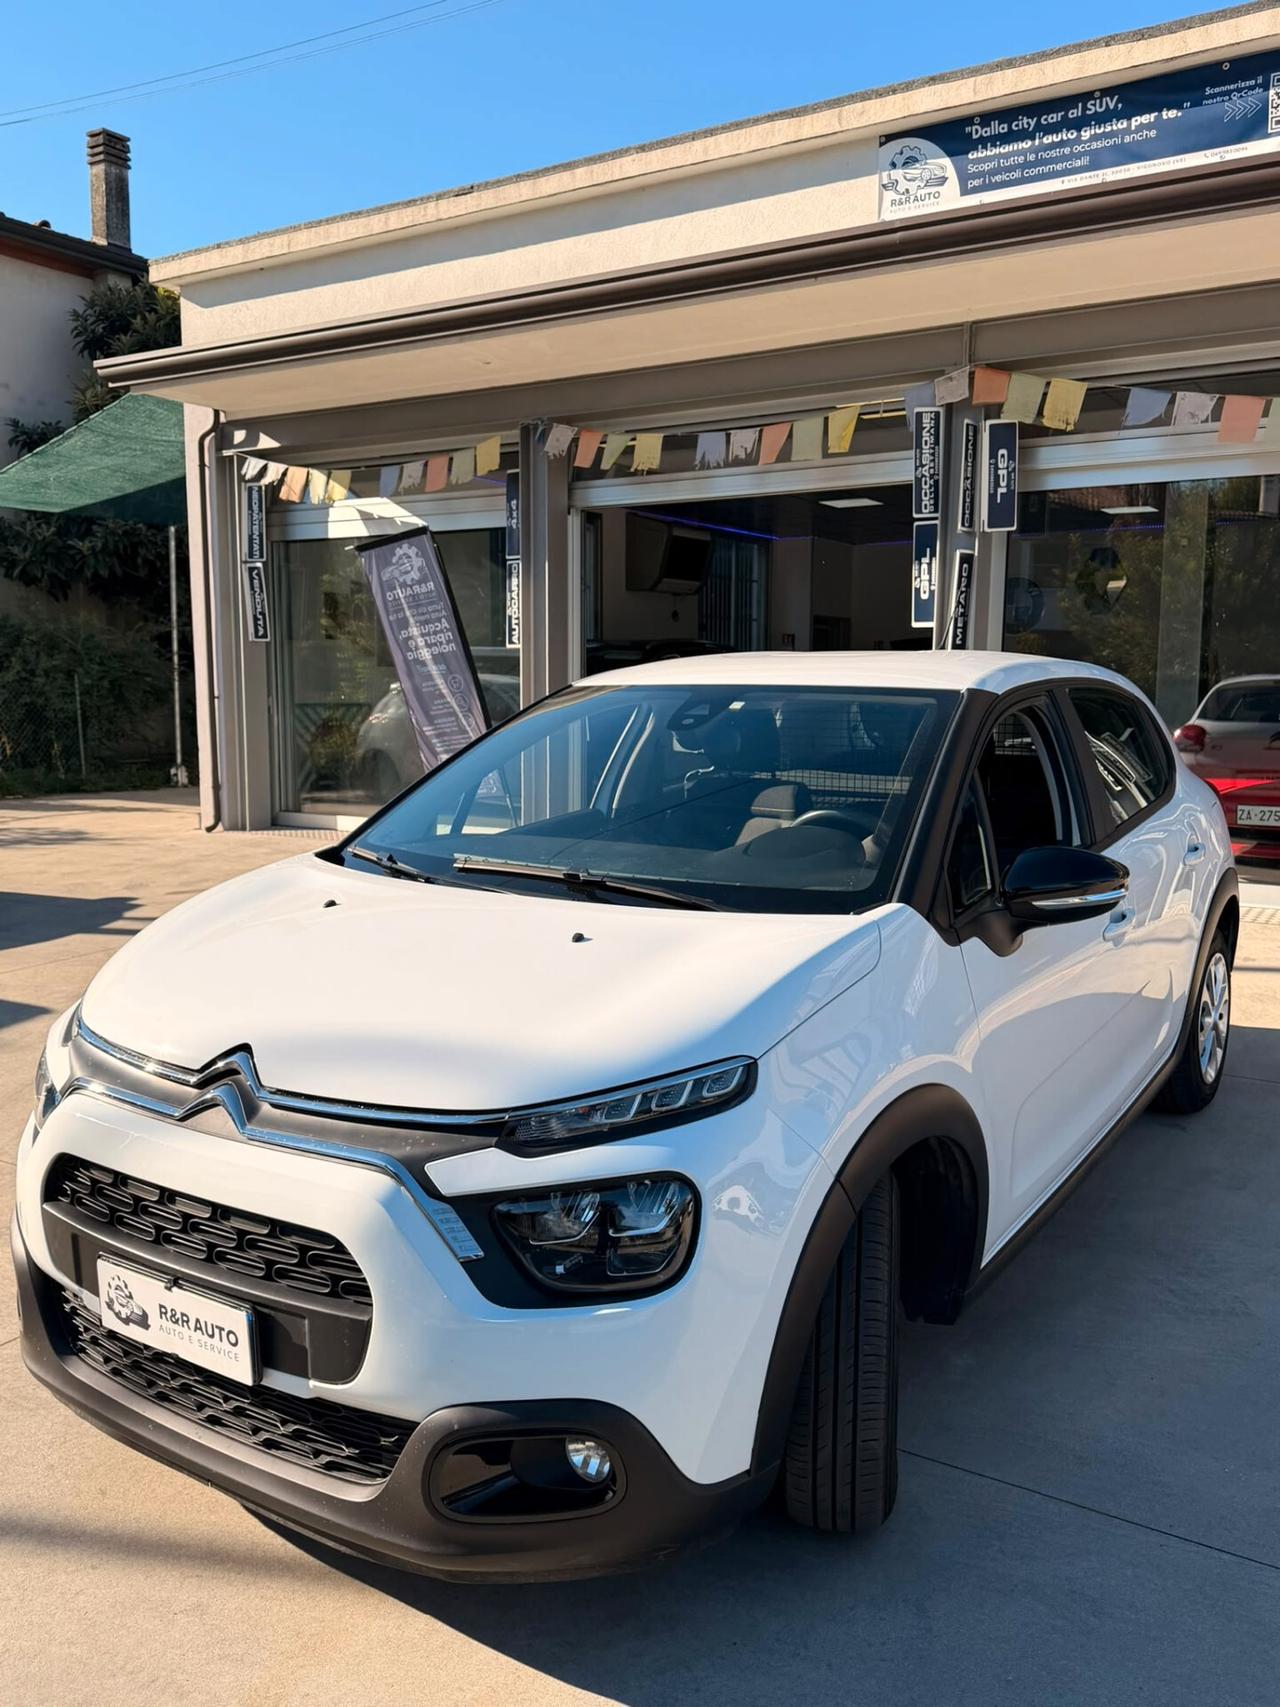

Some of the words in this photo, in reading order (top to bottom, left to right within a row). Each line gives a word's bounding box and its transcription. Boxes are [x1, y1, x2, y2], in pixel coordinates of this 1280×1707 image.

[1202, 95, 1229, 106] nostro
[1230, 86, 1264, 100] QrCode
[1205, 80, 1255, 95] Scannerizza
[1256, 75, 1263, 84] il
[965, 120, 1008, 140] "Dalla
[1012, 115, 1037, 132] city
[1040, 111, 1065, 124] car
[1068, 102, 1082, 118] al
[1086, 95, 1122, 115] SUV,
[968, 141, 1032, 159] abbiamo
[1035, 128, 1078, 146] l'auto
[1080, 118, 1128, 140] giusta
[1130, 111, 1159, 130] per
[1161, 101, 1191, 120] te."
[967, 160, 998, 173] Scopri
[1000, 155, 1025, 167] tutte
[1026, 153, 1036, 161] le
[1038, 147, 1071, 159] nostre
[1072, 135, 1122, 153] occasioni
[1123, 129, 1157, 144] anche
[967, 178, 984, 189] per
[990, 169, 1022, 183] veicoli
[1023, 156, 1090, 177] commerciali!
[922, 412, 931, 513] OCCASIONE
[964, 424, 975, 527] OCCASIONE
[997, 448, 1008, 503] GPL
[251, 486, 260, 559] NEOPATENTATI
[920, 547, 930, 600] GPL
[252, 569, 265, 637] VENDUTA
[159, 1324, 184, 1341] AUTO
[188, 1335, 193, 1344] E
[197, 1338, 240, 1362] SERVICE
